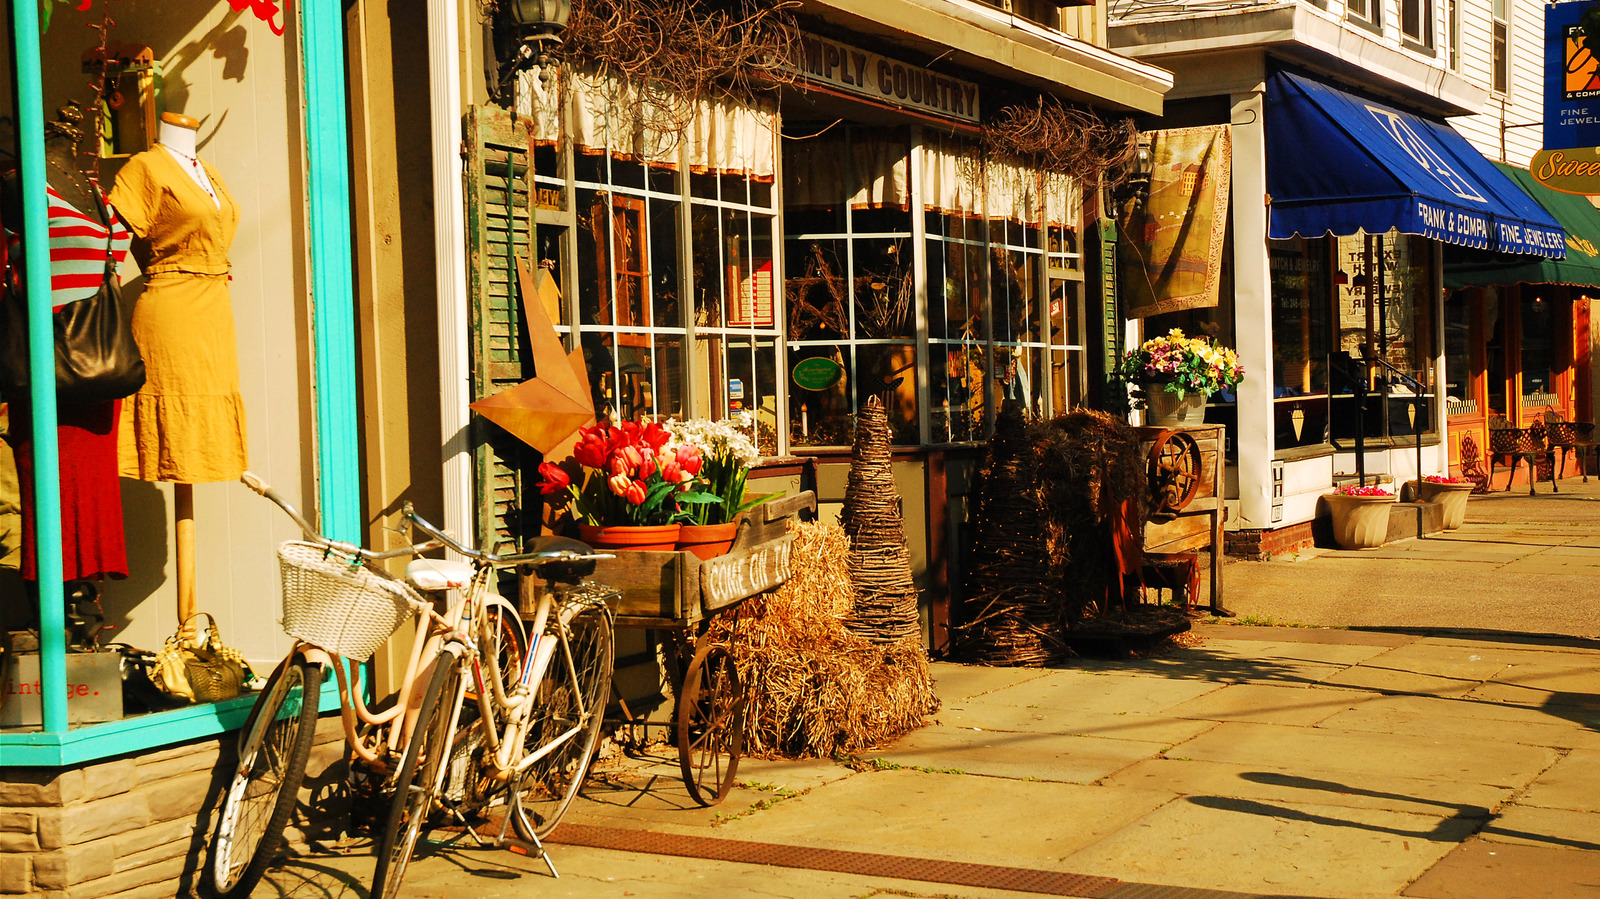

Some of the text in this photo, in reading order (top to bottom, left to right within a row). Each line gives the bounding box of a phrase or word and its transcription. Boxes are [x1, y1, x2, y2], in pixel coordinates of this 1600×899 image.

[774, 31, 976, 118] IMPLY COUNTRY
[1560, 107, 1589, 116] FINE
[1560, 116, 1600, 125] JEWEL
[1538, 151, 1600, 181] Swee
[1418, 202, 1446, 230] FRANK
[1448, 211, 1455, 232] &
[1457, 213, 1498, 240] COMPANY
[1500, 223, 1523, 244] FINE
[1524, 227, 1565, 250] JEWELERS
[709, 540, 792, 601] COME ON IN
[6, 678, 99, 700] intge.
